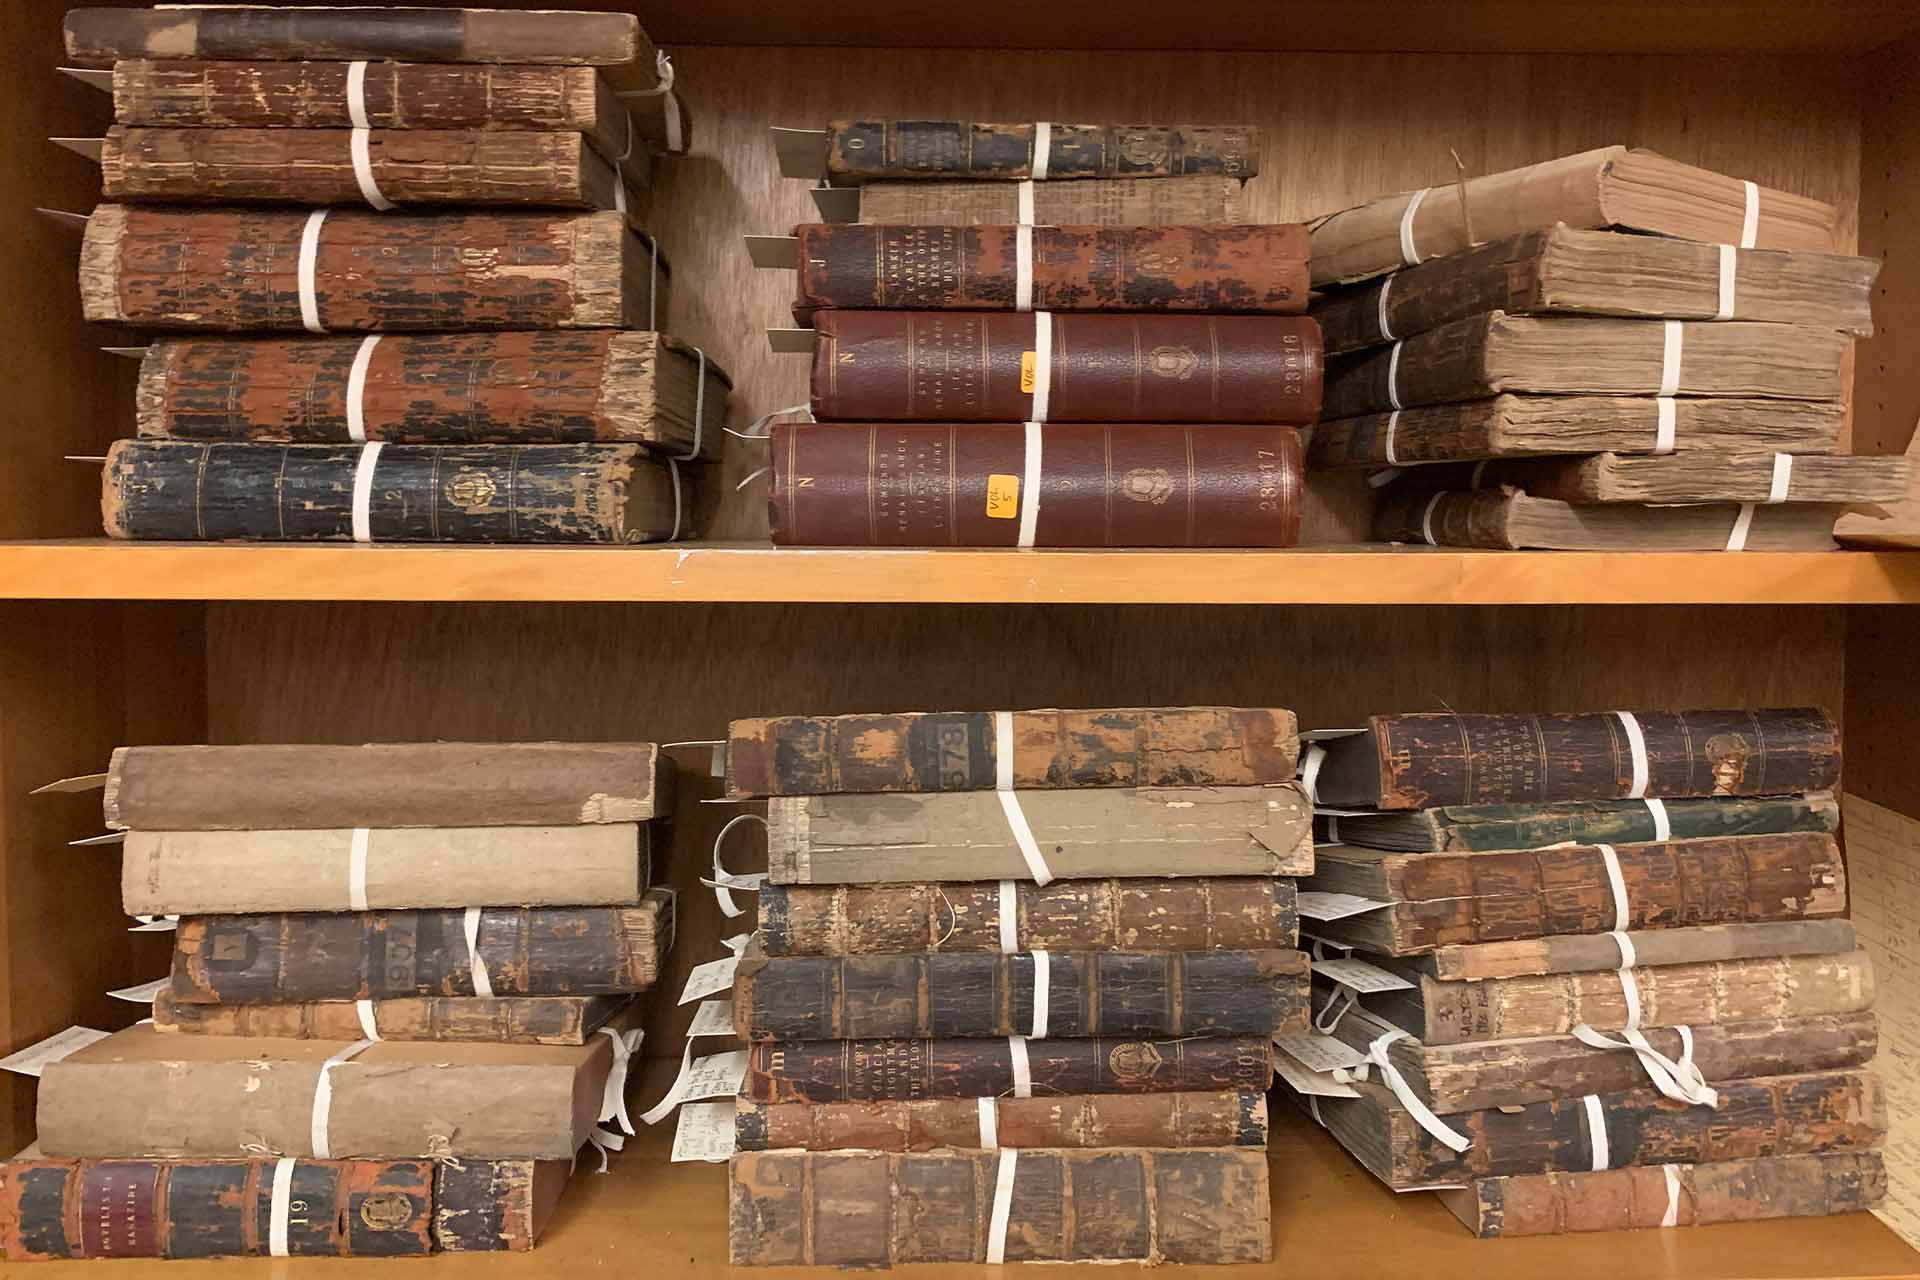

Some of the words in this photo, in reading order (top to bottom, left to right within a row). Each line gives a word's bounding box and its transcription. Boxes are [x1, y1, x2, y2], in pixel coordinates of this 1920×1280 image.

[838, 352, 856, 365] N
[798, 476, 816, 489] N
[385, 489, 403, 500] 2
[898, 1048, 909, 1077] AND
[910, 1074, 921, 1098] THE
[289, 1199, 309, 1225] 19
